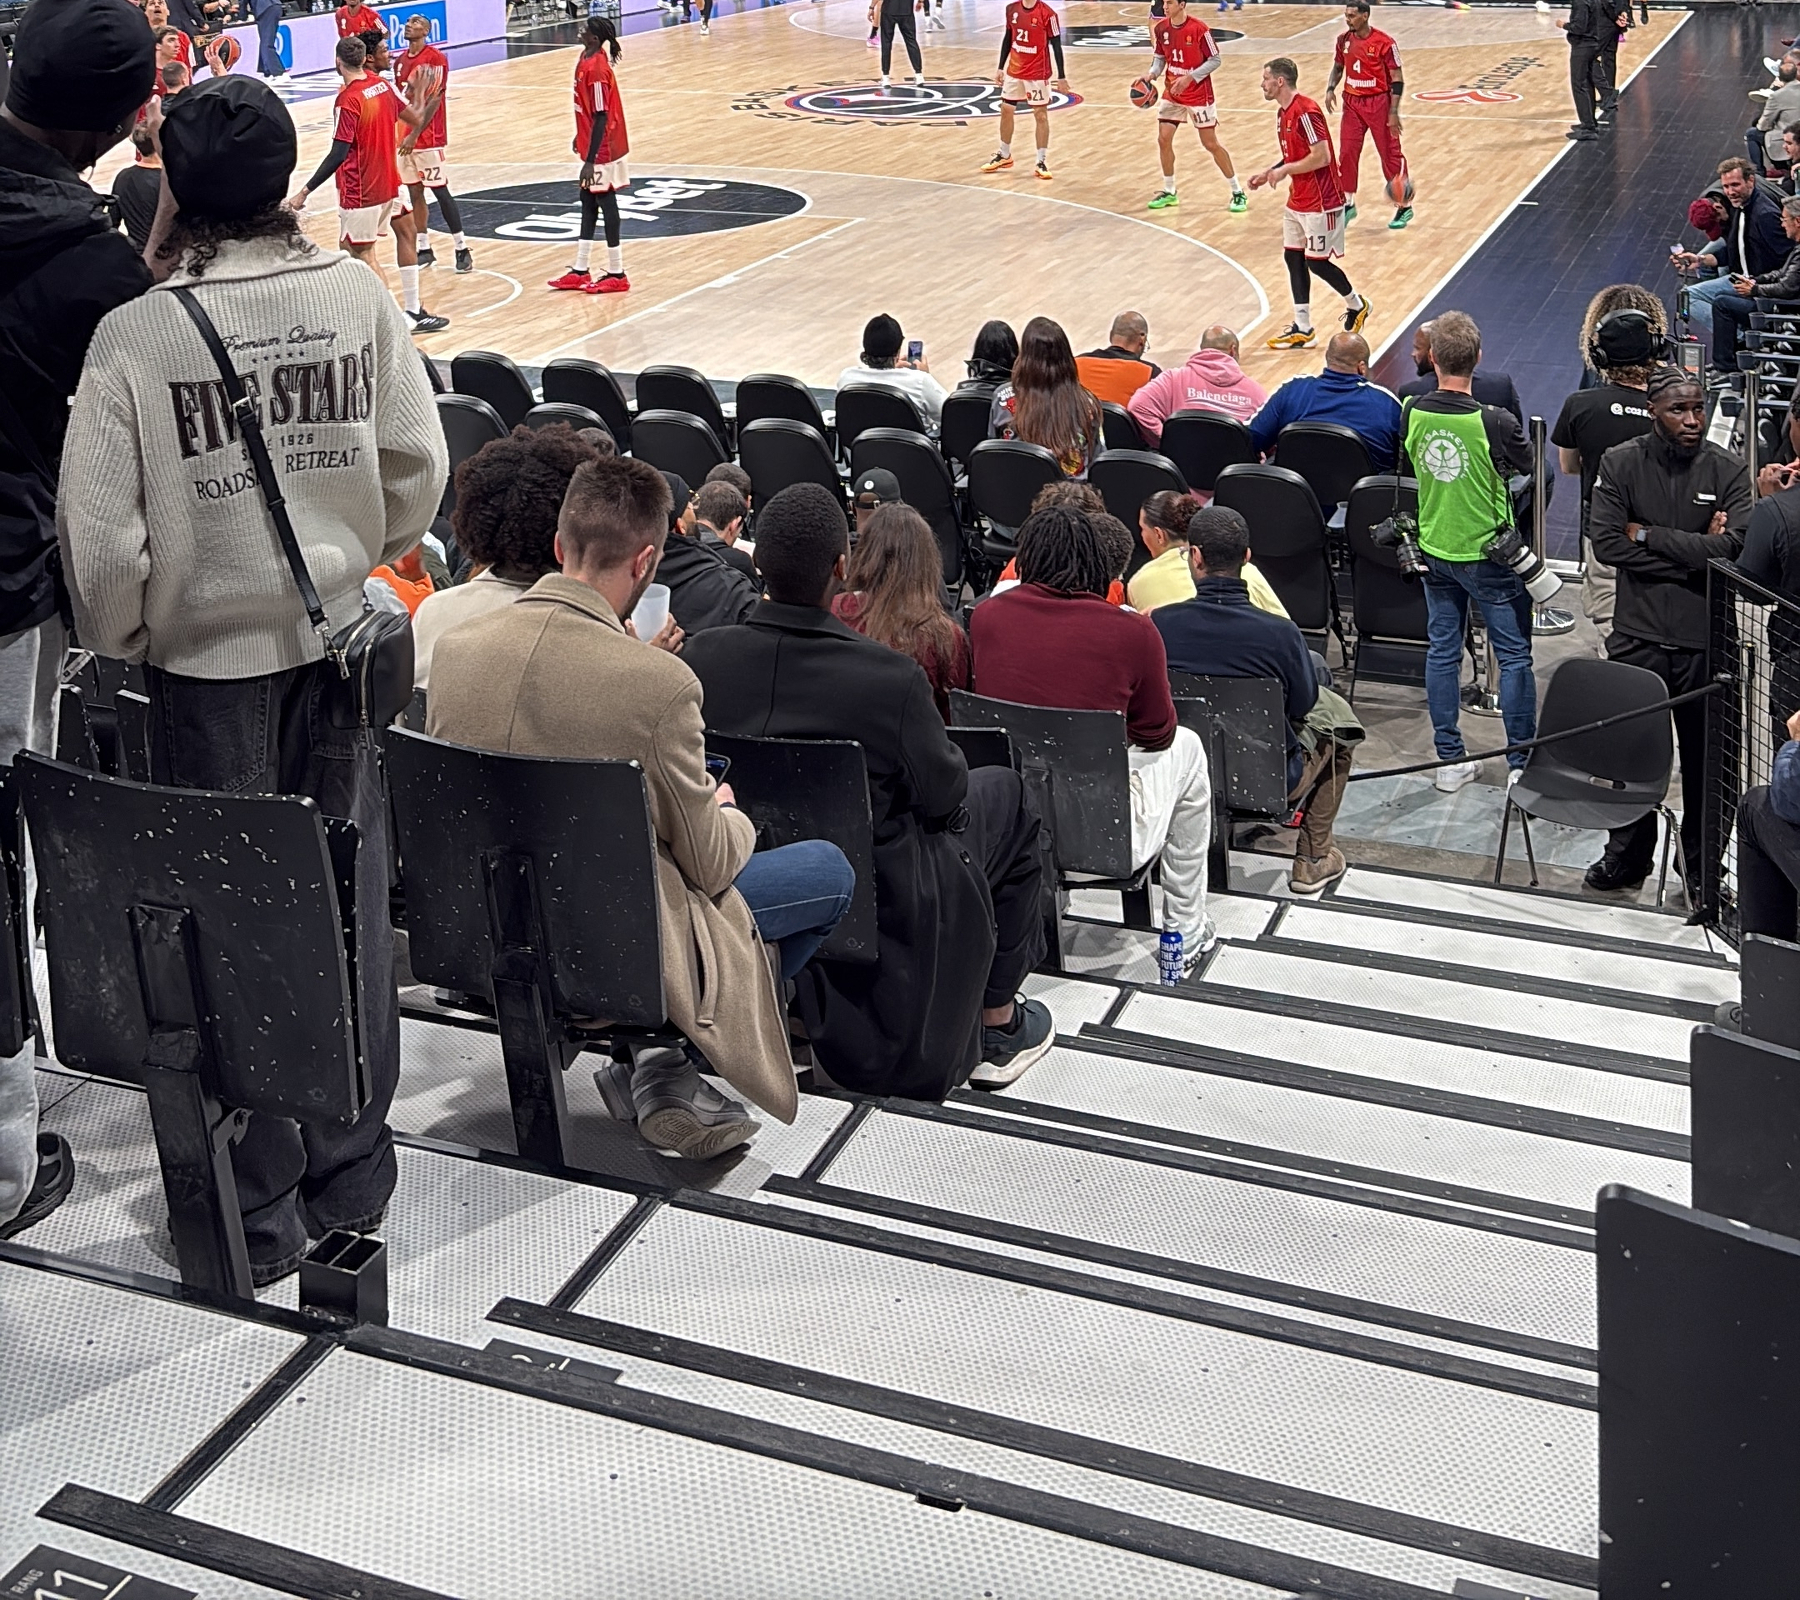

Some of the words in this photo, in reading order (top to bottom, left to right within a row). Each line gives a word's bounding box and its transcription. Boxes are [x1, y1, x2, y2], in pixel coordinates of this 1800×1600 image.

[1016, 28, 1030, 43] 21
[1171, 48, 1185, 63] 11
[1352, 59, 1362, 74] 4
[1032, 89, 1045, 101] 21
[753, 110, 970, 128] PARIS
[1196, 109, 1211, 124] 11
[423, 166, 442, 182] 22
[1307, 235, 1326, 252] 13
[221, 334, 280, 353] Premium
[286, 325, 338, 348] Quality
[168, 370, 264, 461] FIVE
[270, 342, 375, 427] STARS
[1186, 387, 1252, 406] Balenciaga
[280, 432, 315, 448] 1926
[285, 447, 360, 474] RETREAT
[1161, 941, 1183, 952] SHAPE
[1161, 950, 1175, 961] THE
[10, 1568, 45, 1594] RANG
